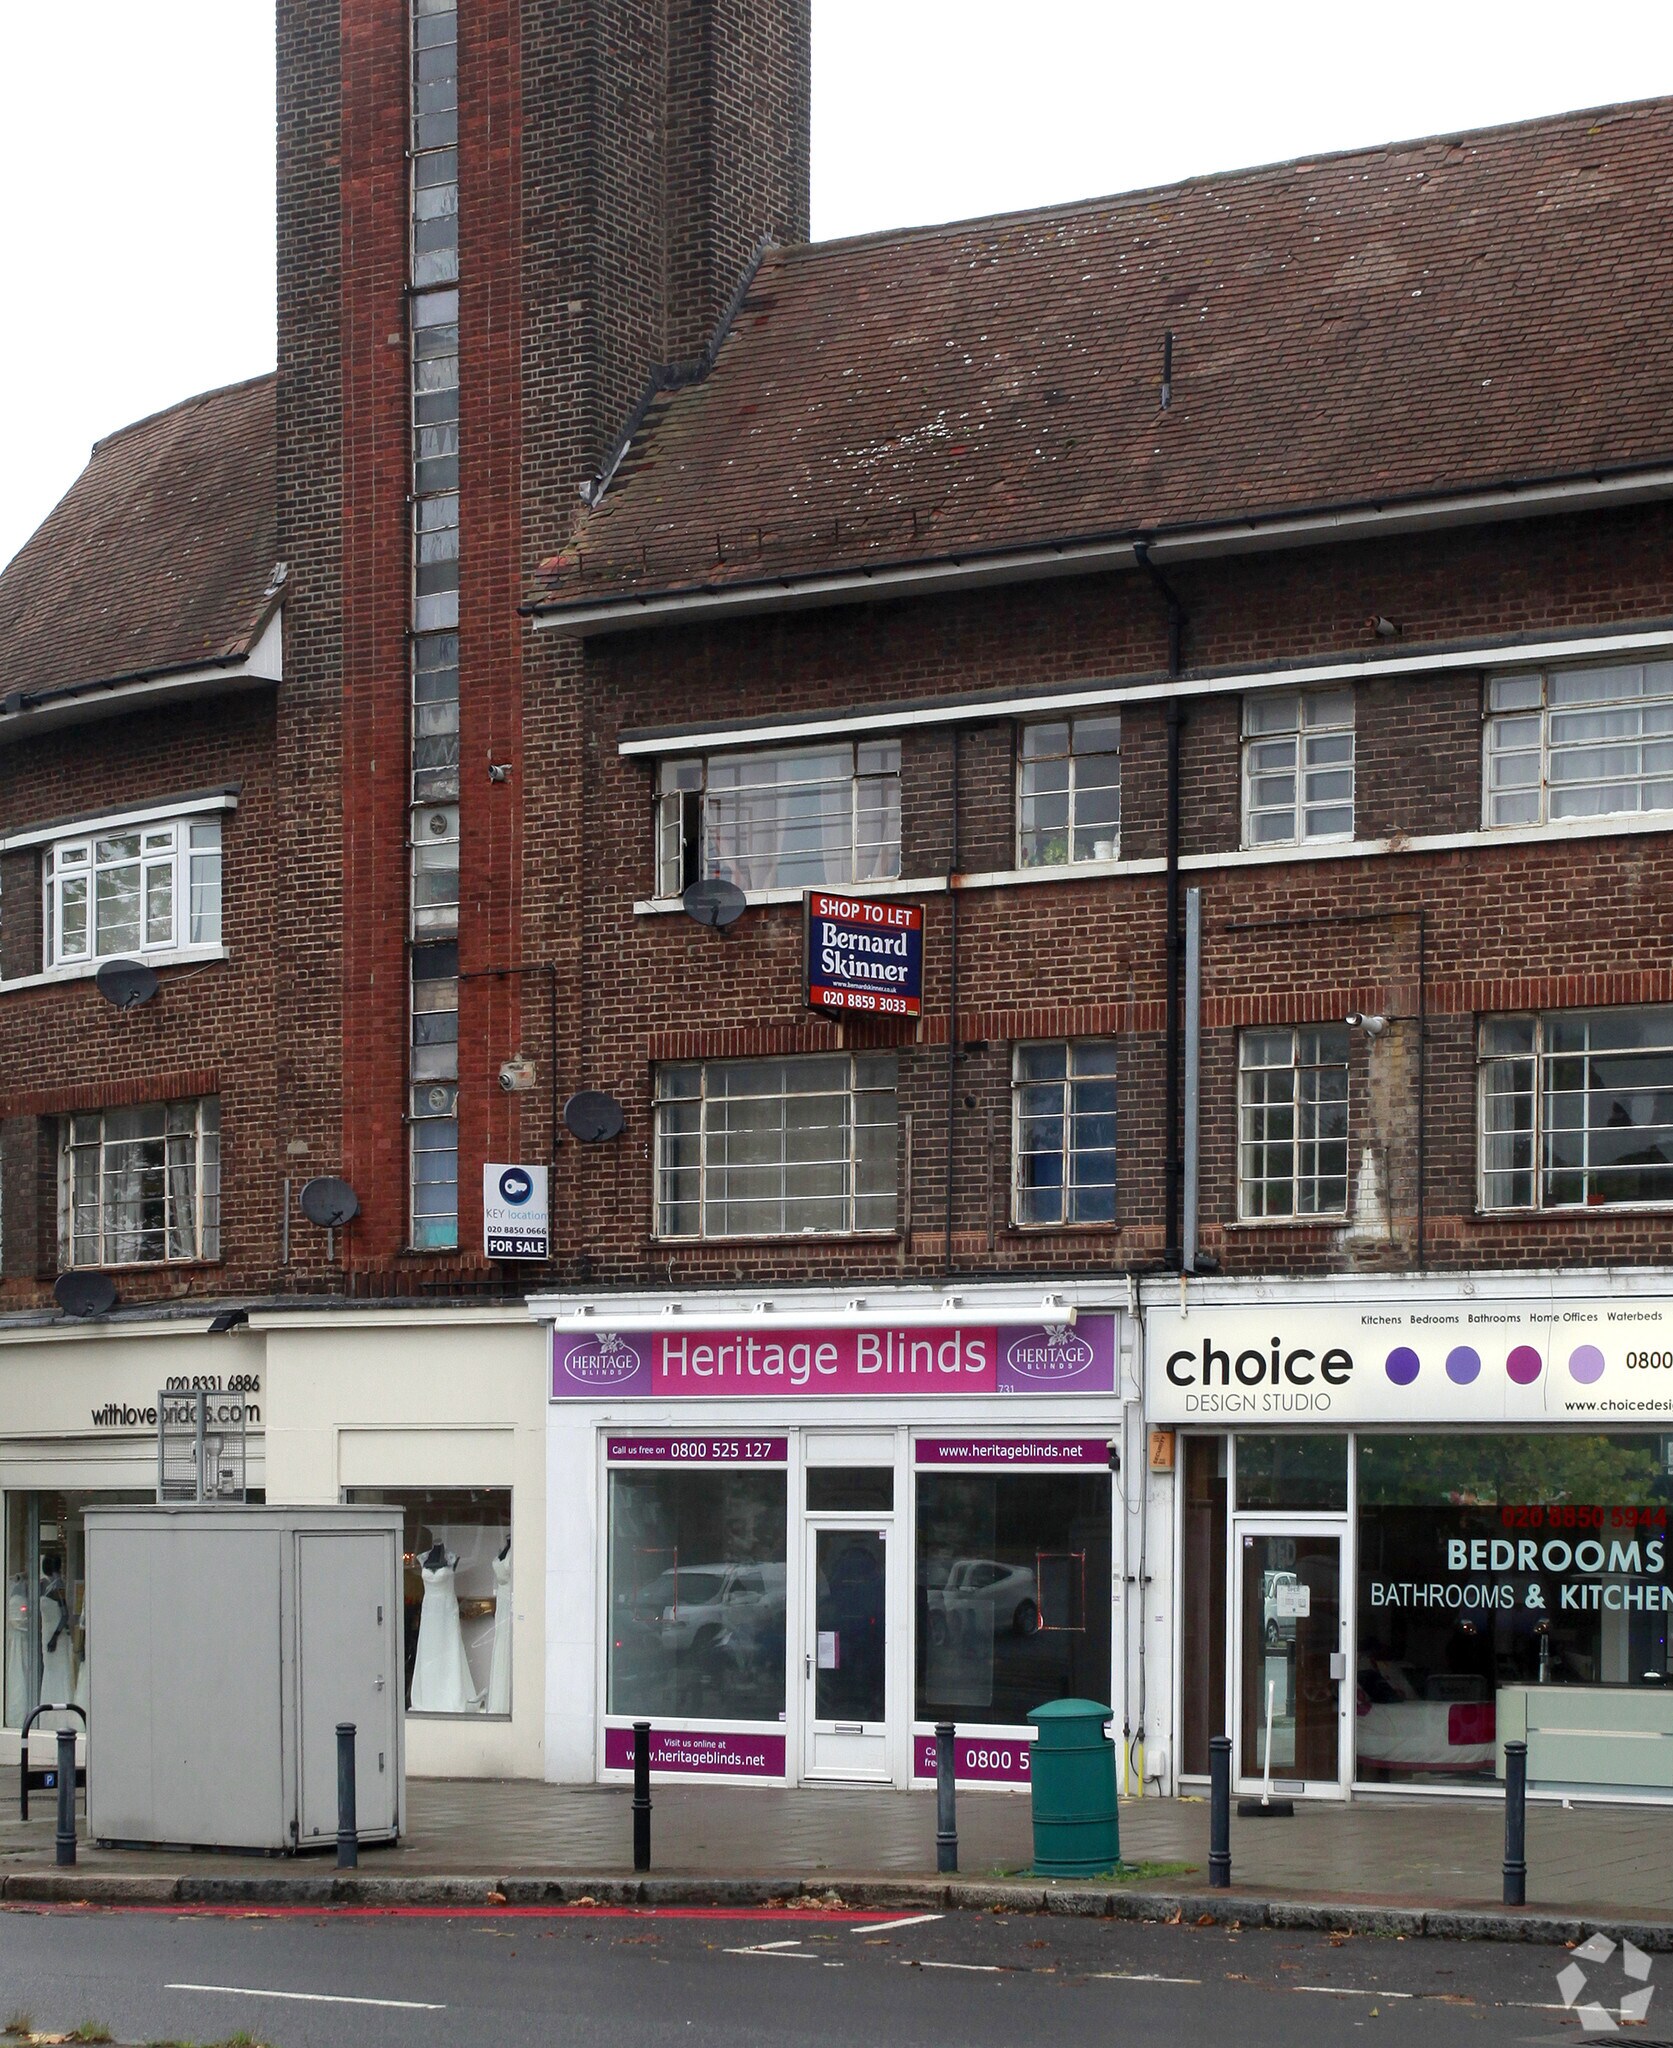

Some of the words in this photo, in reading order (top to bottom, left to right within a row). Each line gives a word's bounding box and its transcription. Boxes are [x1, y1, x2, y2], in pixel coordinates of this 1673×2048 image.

[820, 898, 860, 918] SHOP
[864, 904, 884, 922] TO
[888, 908, 912, 926] LET
[822, 922, 908, 956] Bernard
[822, 948, 908, 982] Skinner
[823, 990, 844, 1006] 020
[848, 994, 876, 1009] 8859
[879, 997, 906, 1013] 3033
[486, 1209, 505, 1218] KEY
[508, 1210, 547, 1220] location
[504, 1226, 524, 1234] 8850
[526, 1227, 547, 1235] 0666
[490, 1240, 513, 1252] FOR
[516, 1241, 545, 1253] SALE
[1360, 1315, 1402, 1325] Kitchens
[1410, 1314, 1460, 1324] Bedrooms
[1468, 1314, 1522, 1324] Bathrooms
[1529, 1313, 1560, 1322] Home
[1562, 1312, 1599, 1322] Offices
[1606, 1311, 1663, 1322] Waterbeds
[572, 1354, 633, 1370] HERITAGE
[662, 1336, 838, 1385] Heritage
[856, 1330, 986, 1374] Blinds
[1016, 1348, 1085, 1362] HERITAGE
[1166, 1336, 1354, 1387] choice
[1626, 1351, 1673, 1369] 0800
[582, 1368, 622, 1376] BLINDS
[1027, 1362, 1074, 1370] BLINDS
[166, 1376, 190, 1390] 020
[192, 1375, 222, 1390] 8331
[227, 1374, 260, 1392] 6886
[998, 1384, 1014, 1393] 731
[1185, 1394, 1256, 1412] DESIGN
[1262, 1392, 1332, 1412] STUDIO
[1564, 1398, 1673, 1412] www.choicedesi
[612, 1446, 626, 1454] Call
[638, 1446, 654, 1454] free
[670, 1442, 707, 1458] 0800
[712, 1442, 739, 1458] 525
[744, 1443, 772, 1458] 127
[938, 1444, 1082, 1459] www.heritageblinds.net
[1502, 1505, 1544, 1528] 020
[1548, 1505, 1604, 1528] 8850
[1448, 1540, 1665, 1573] BEDROOMS
[1371, 1583, 1514, 1609] BATHROOMS
[1524, 1584, 1546, 1610] &
[664, 1738, 680, 1748] Visit
[682, 1740, 692, 1748] us
[693, 1739, 716, 1748] online
[718, 1740, 726, 1749] at
[926, 1747, 937, 1756] Ca
[626, 1750, 765, 1767] ww.heritageblinds.net
[924, 1758, 938, 1767] fre
[966, 1750, 1012, 1769] 0800
[46, 1774, 53, 1785] P
